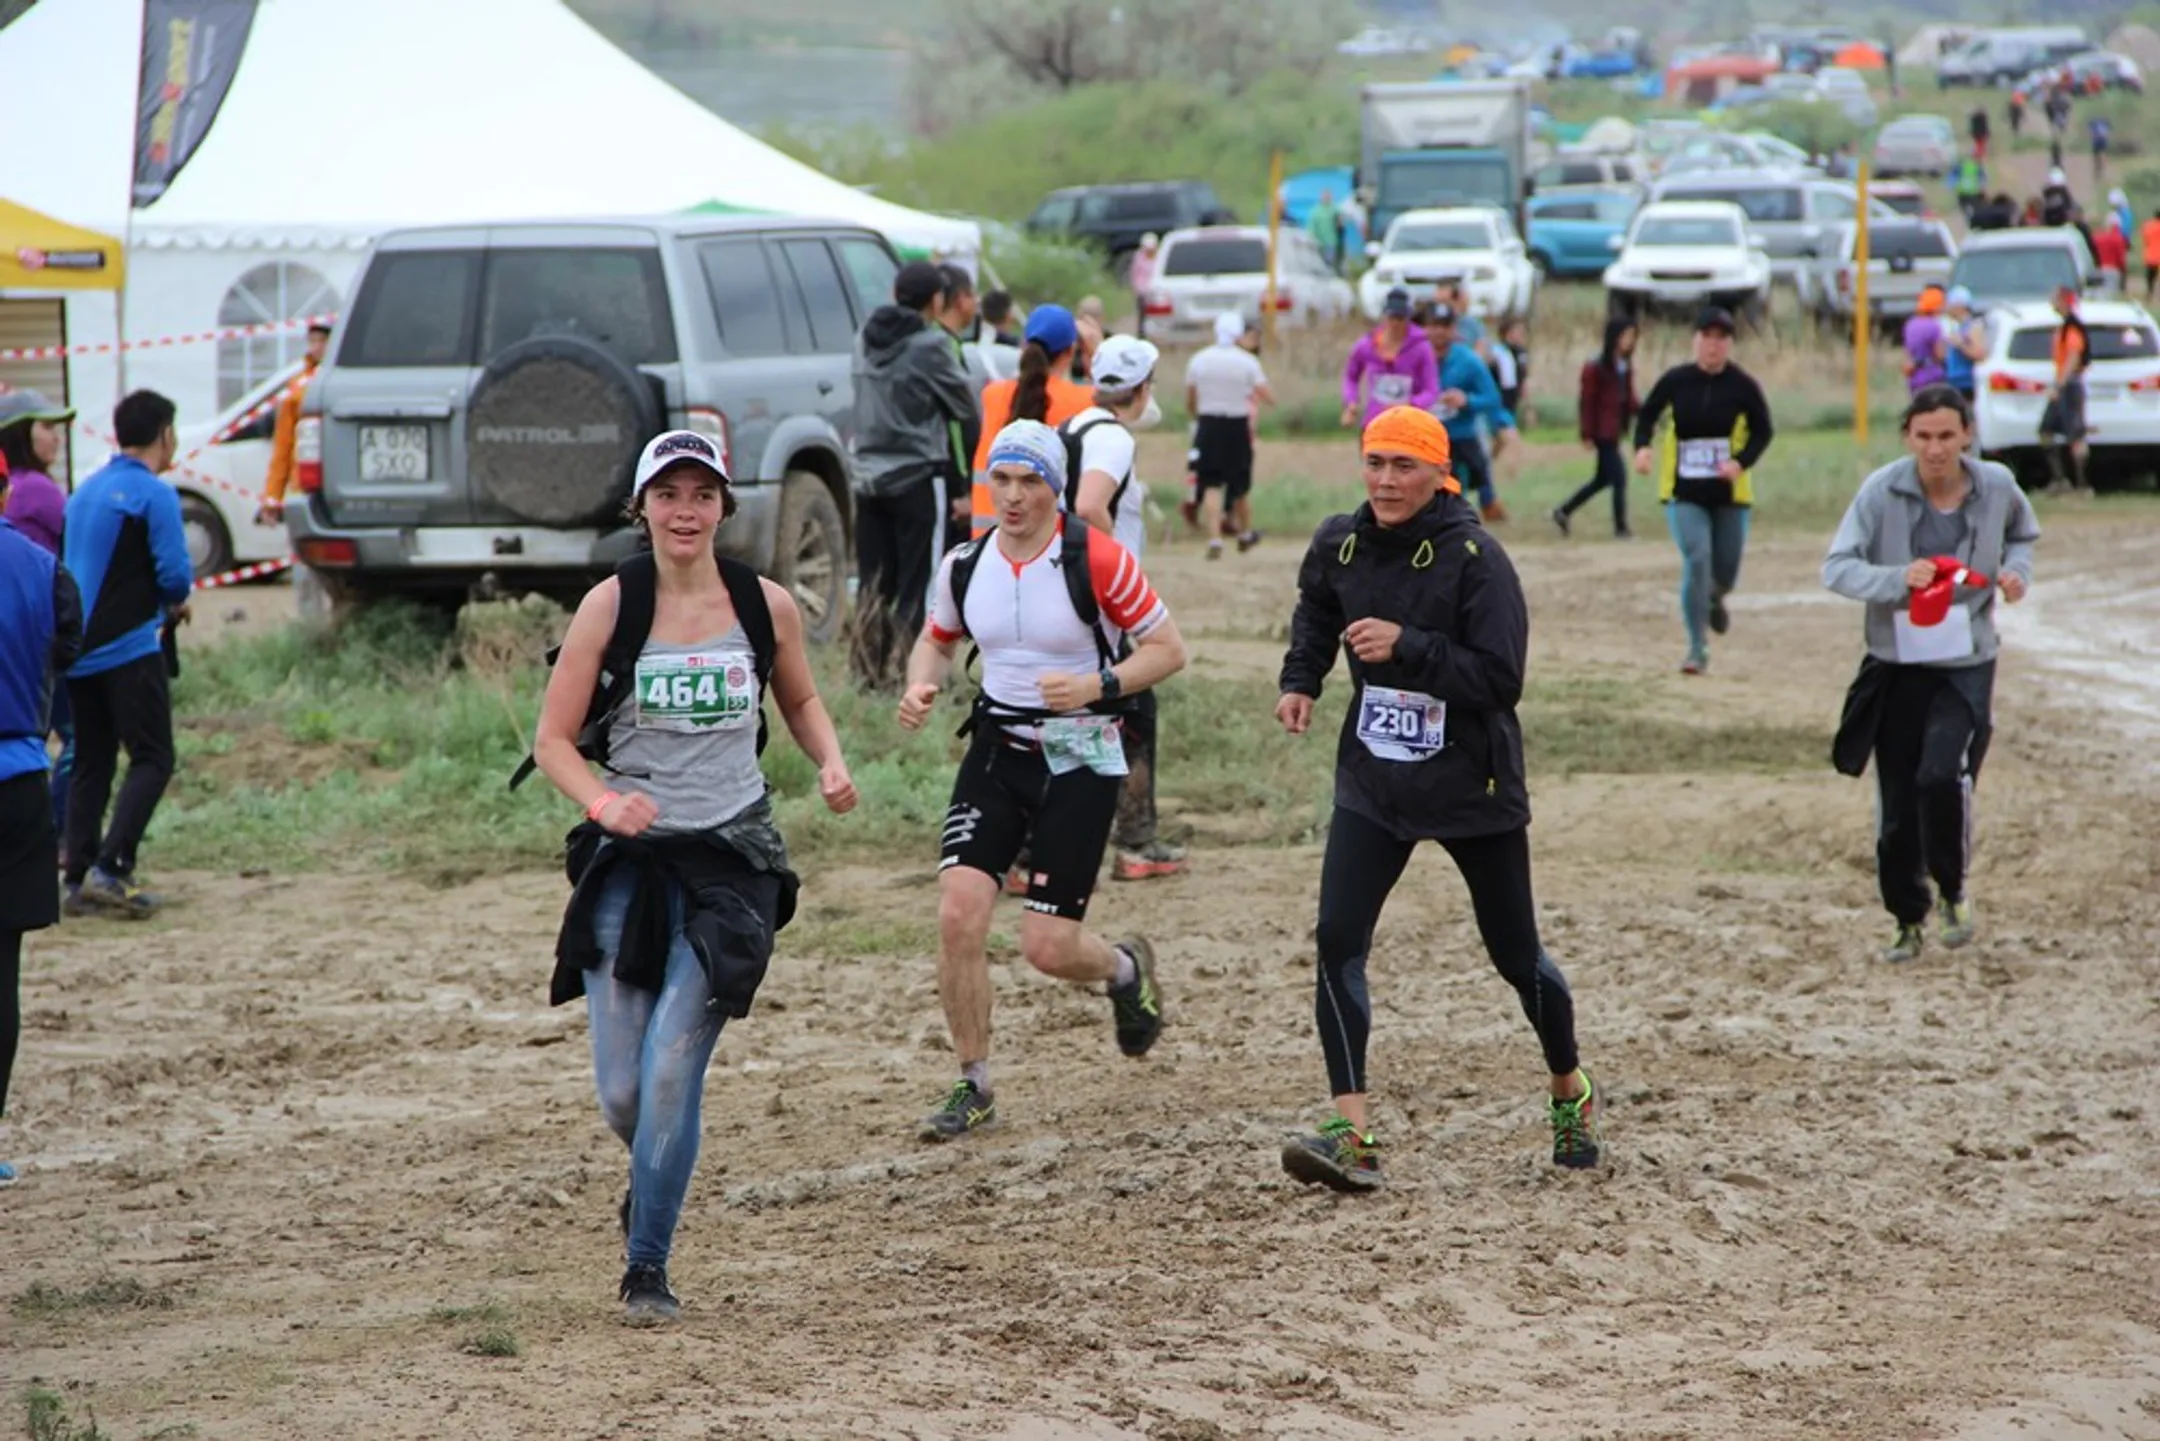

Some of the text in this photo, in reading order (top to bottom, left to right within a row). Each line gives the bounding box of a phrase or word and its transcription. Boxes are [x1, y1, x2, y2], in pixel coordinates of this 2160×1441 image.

[476, 426, 579, 443] PATROL
[648, 674, 719, 708] 464
[1369, 705, 1419, 738] 230
